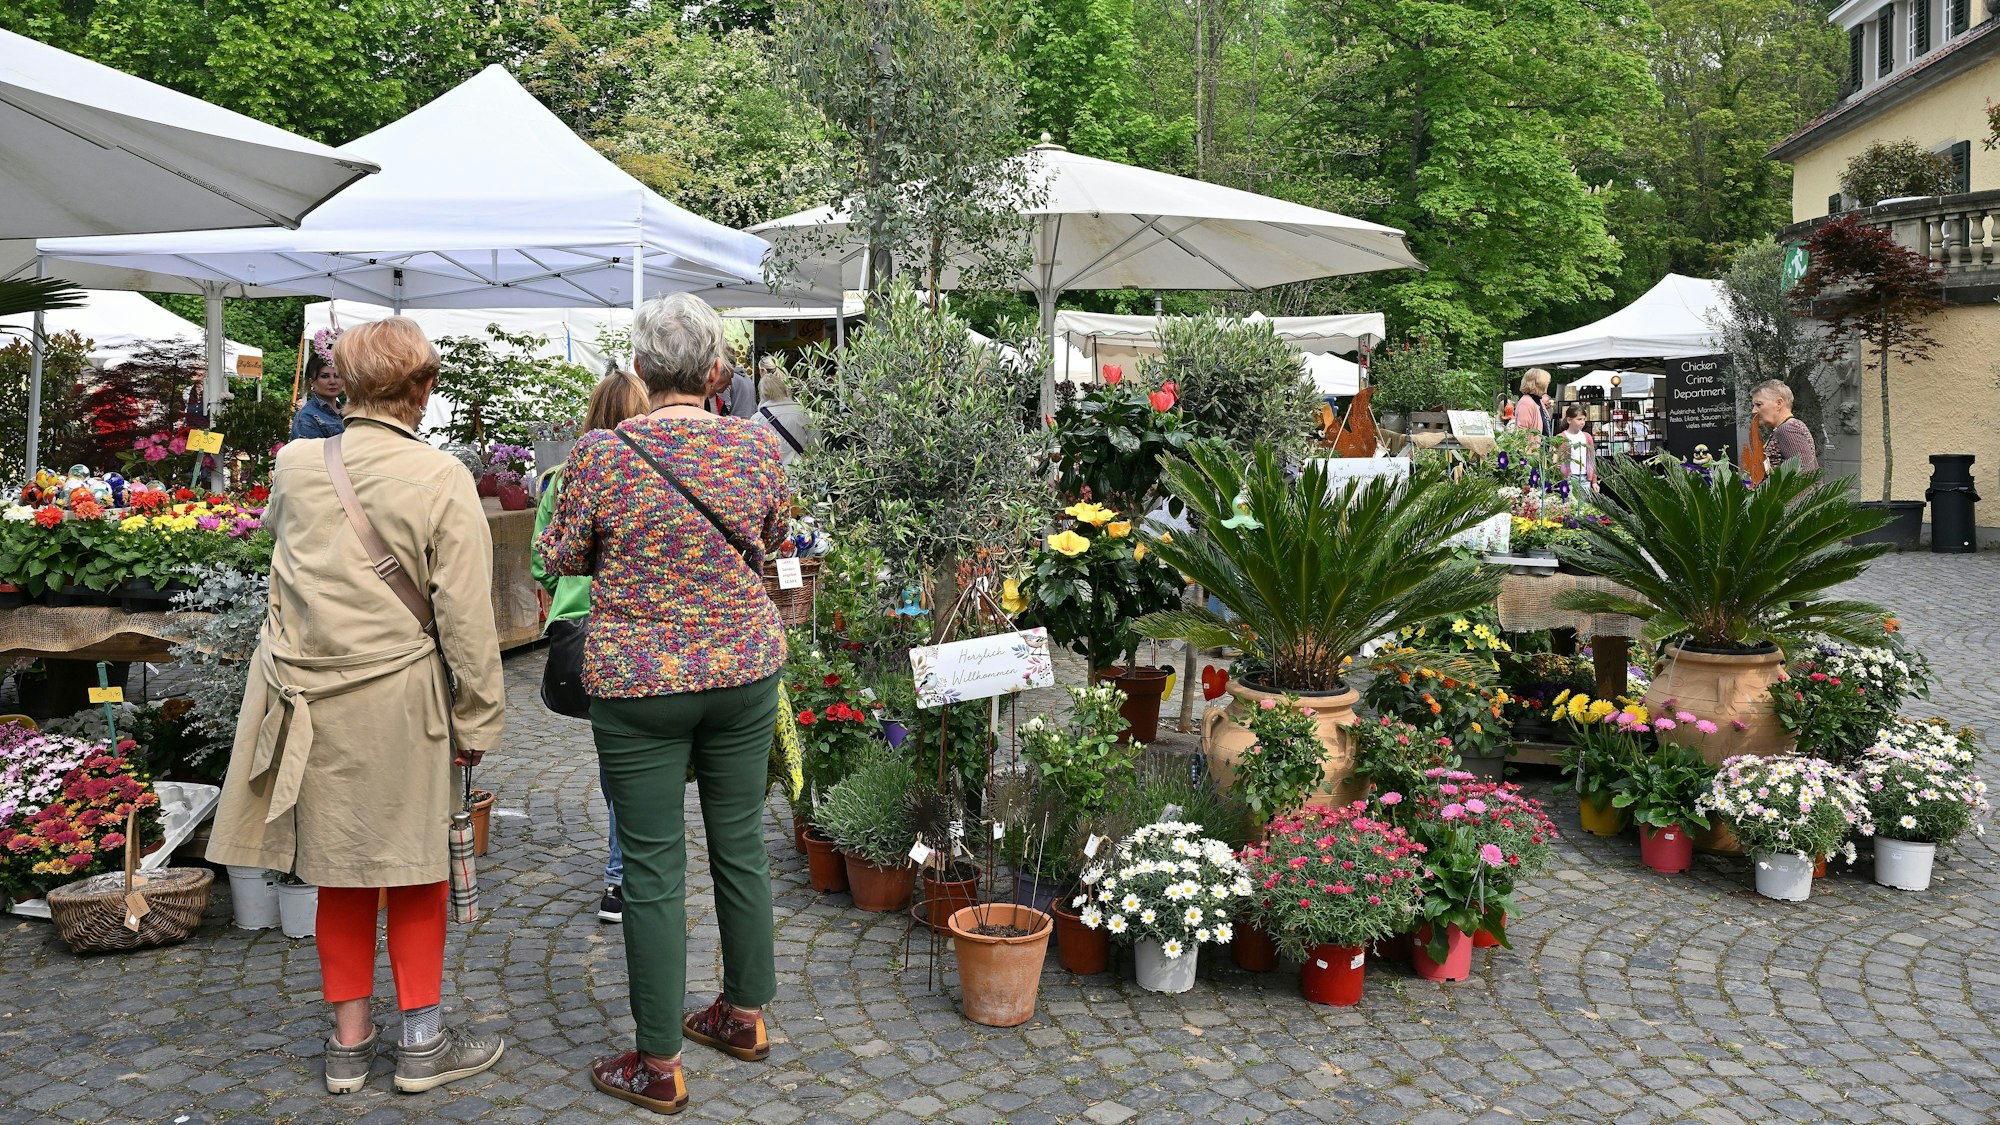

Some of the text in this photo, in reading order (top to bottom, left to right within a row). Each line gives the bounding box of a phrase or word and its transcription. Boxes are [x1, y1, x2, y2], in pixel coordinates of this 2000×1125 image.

[1681, 360, 1717, 372] Chicken
[1685, 374, 1714, 385] Crime
[1673, 386, 1727, 401] Department
[958, 645, 1006, 665] Herzlich
[952, 668, 1018, 686] Willkommen
